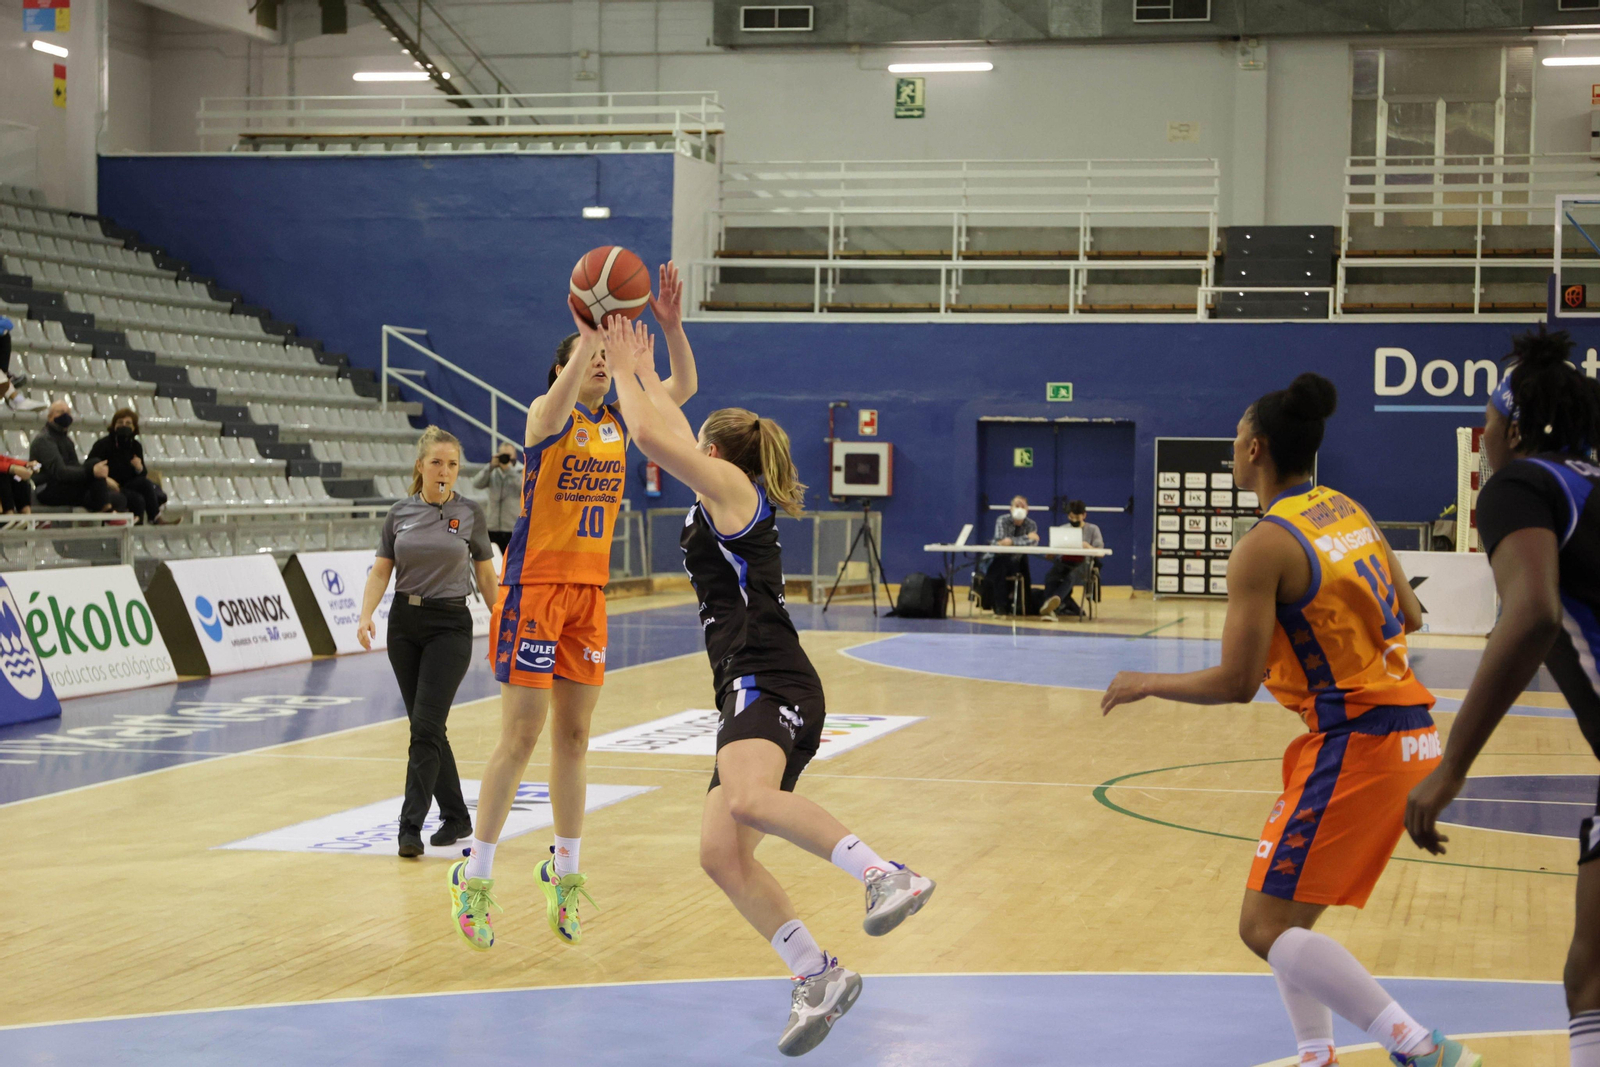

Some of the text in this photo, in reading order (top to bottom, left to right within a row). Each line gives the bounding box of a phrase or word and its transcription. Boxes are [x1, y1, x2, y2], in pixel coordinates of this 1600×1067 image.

[562, 454, 621, 474] Cultura
[576, 505, 604, 538] 10
[26, 590, 153, 659] ékolo
[218, 595, 290, 627] ORBINOX
[109, 655, 171, 680] ecológicos
